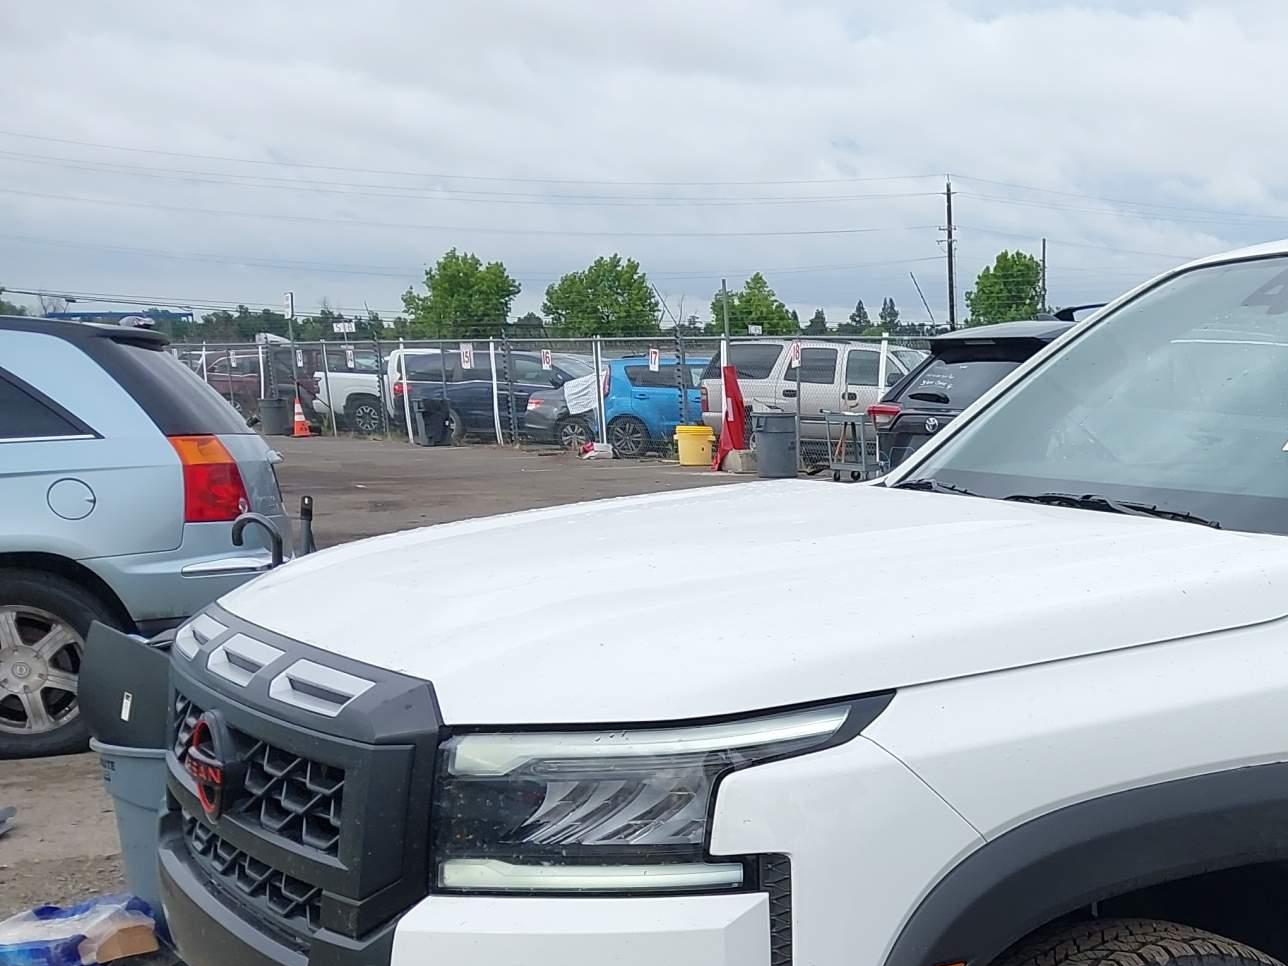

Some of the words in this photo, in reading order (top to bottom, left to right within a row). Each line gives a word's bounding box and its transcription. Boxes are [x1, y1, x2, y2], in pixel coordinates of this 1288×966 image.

[462, 351, 470, 363] 15
[542, 352, 551, 365] 16
[650, 351, 658, 366] 17
